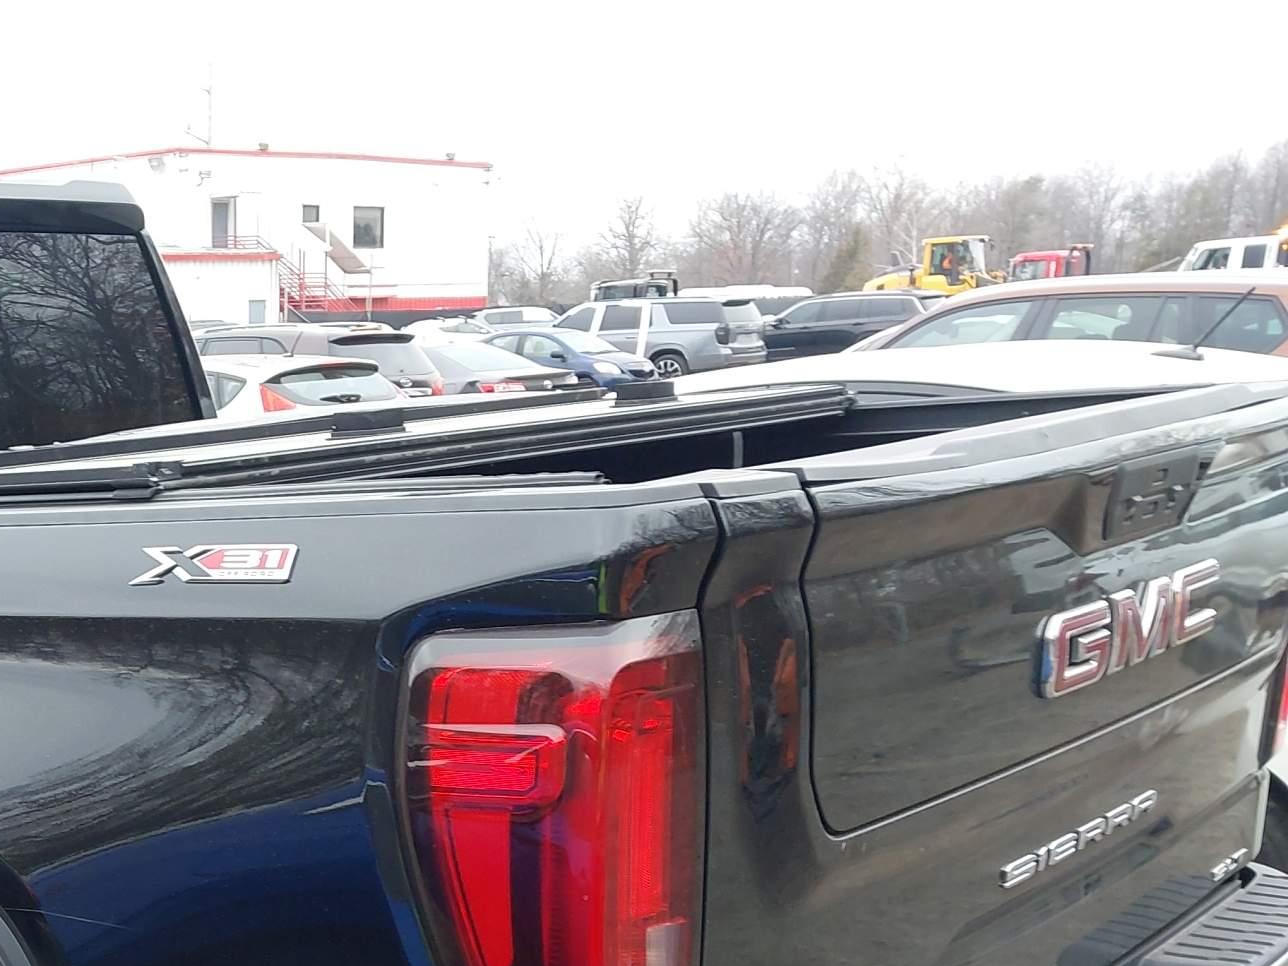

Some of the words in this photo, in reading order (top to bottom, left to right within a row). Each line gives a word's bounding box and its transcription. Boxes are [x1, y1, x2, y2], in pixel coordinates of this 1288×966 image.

[128, 544, 299, 586] X31
[1037, 558, 1220, 699] GMC
[999, 789, 1158, 889] SIERRA
